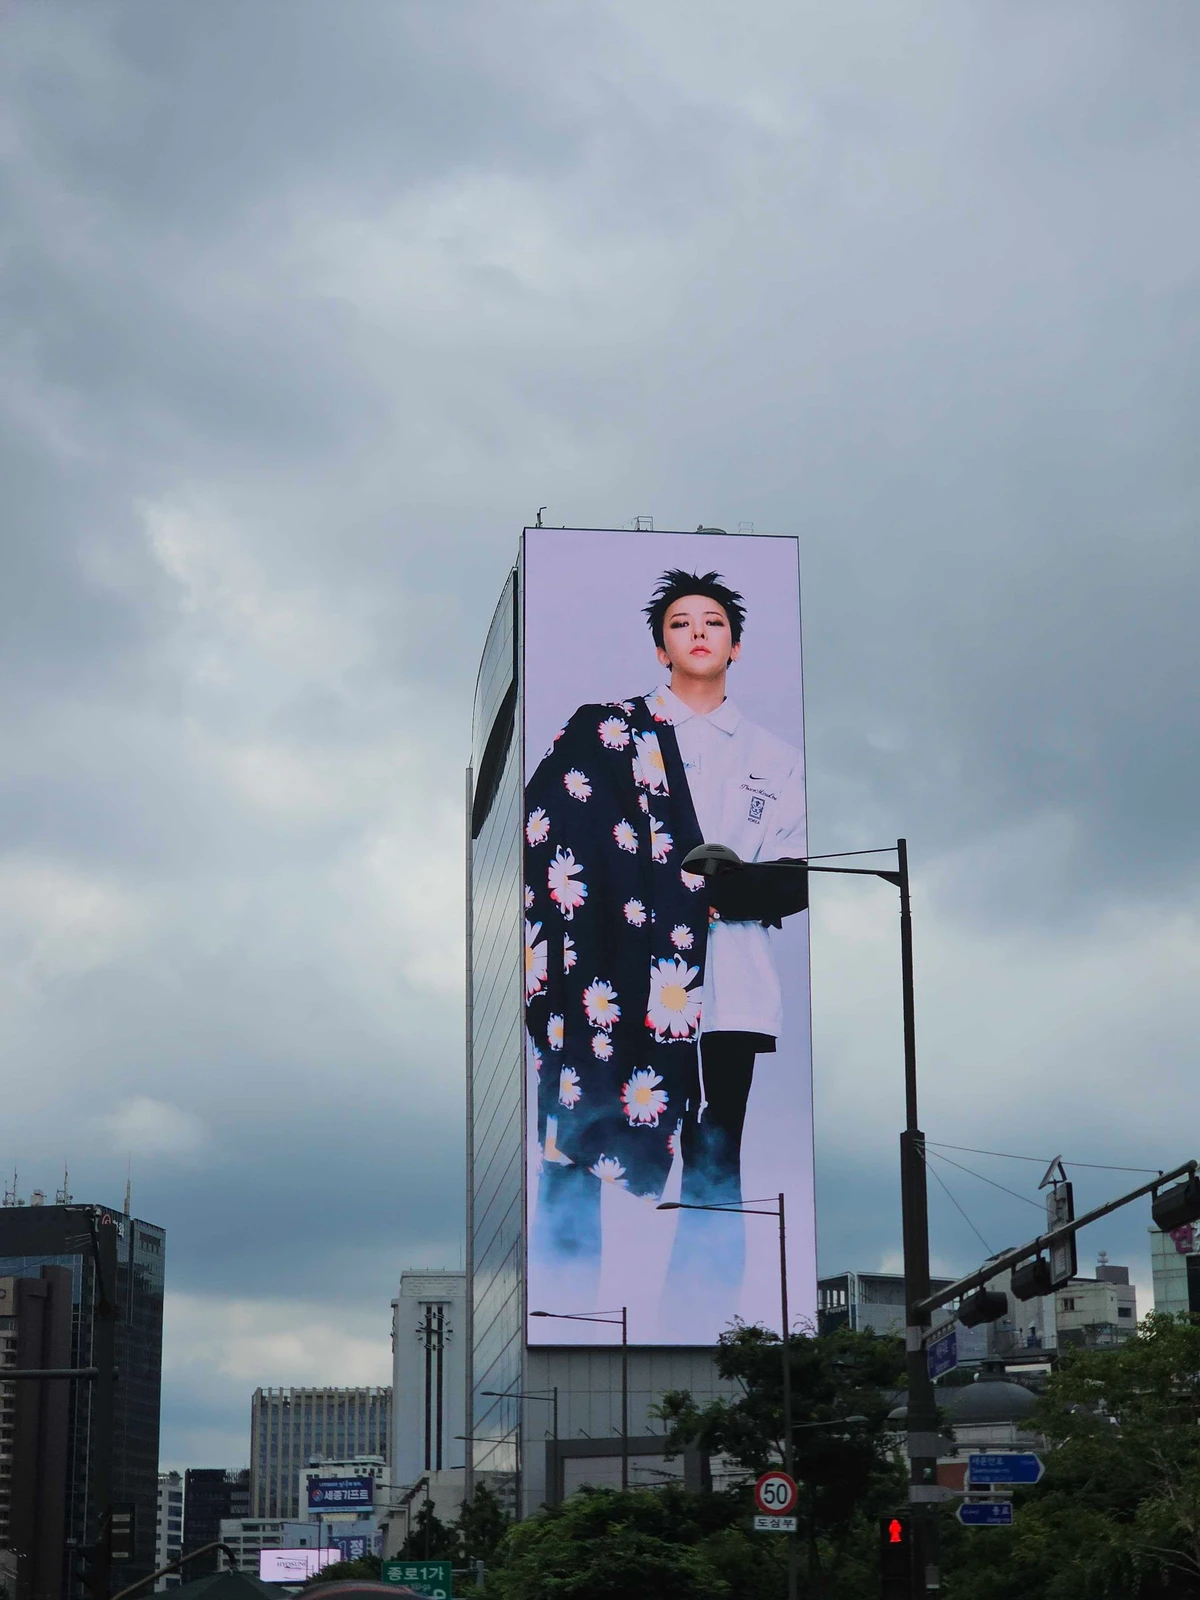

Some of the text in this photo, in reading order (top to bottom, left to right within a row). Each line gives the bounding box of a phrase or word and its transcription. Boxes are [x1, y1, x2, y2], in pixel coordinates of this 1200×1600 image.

[324, 1489, 369, 1501] 세종기프트
[764, 1483, 788, 1504] 50
[756, 1518, 794, 1528] 도심부
[387, 1566, 445, 1581] 종로1가
